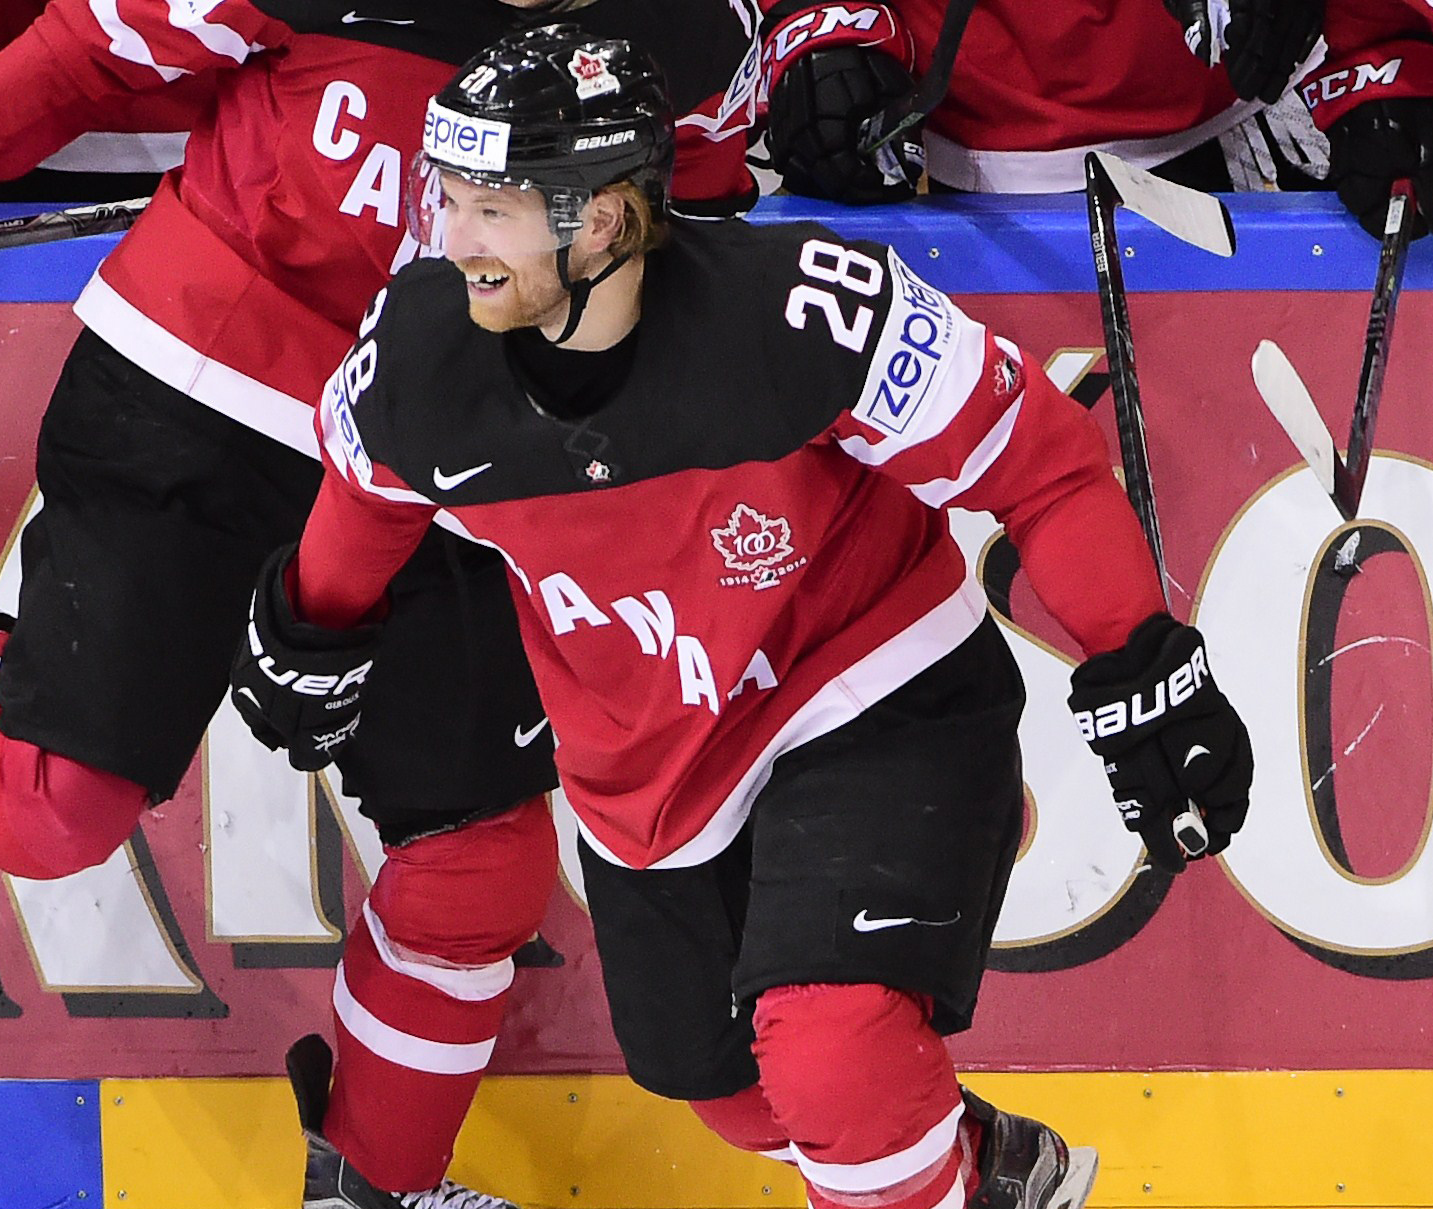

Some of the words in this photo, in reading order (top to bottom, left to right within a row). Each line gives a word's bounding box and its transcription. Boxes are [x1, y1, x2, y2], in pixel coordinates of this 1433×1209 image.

[1302, 57, 1403, 111] CCM
[573, 129, 637, 152] BAUER
[784, 238, 885, 354] 28
[733, 530, 776, 557] 100
[719, 574, 750, 587] 1914
[777, 556, 809, 577] 2014
[247, 588, 374, 697] UER
[1073, 645, 1209, 743] BAUER
